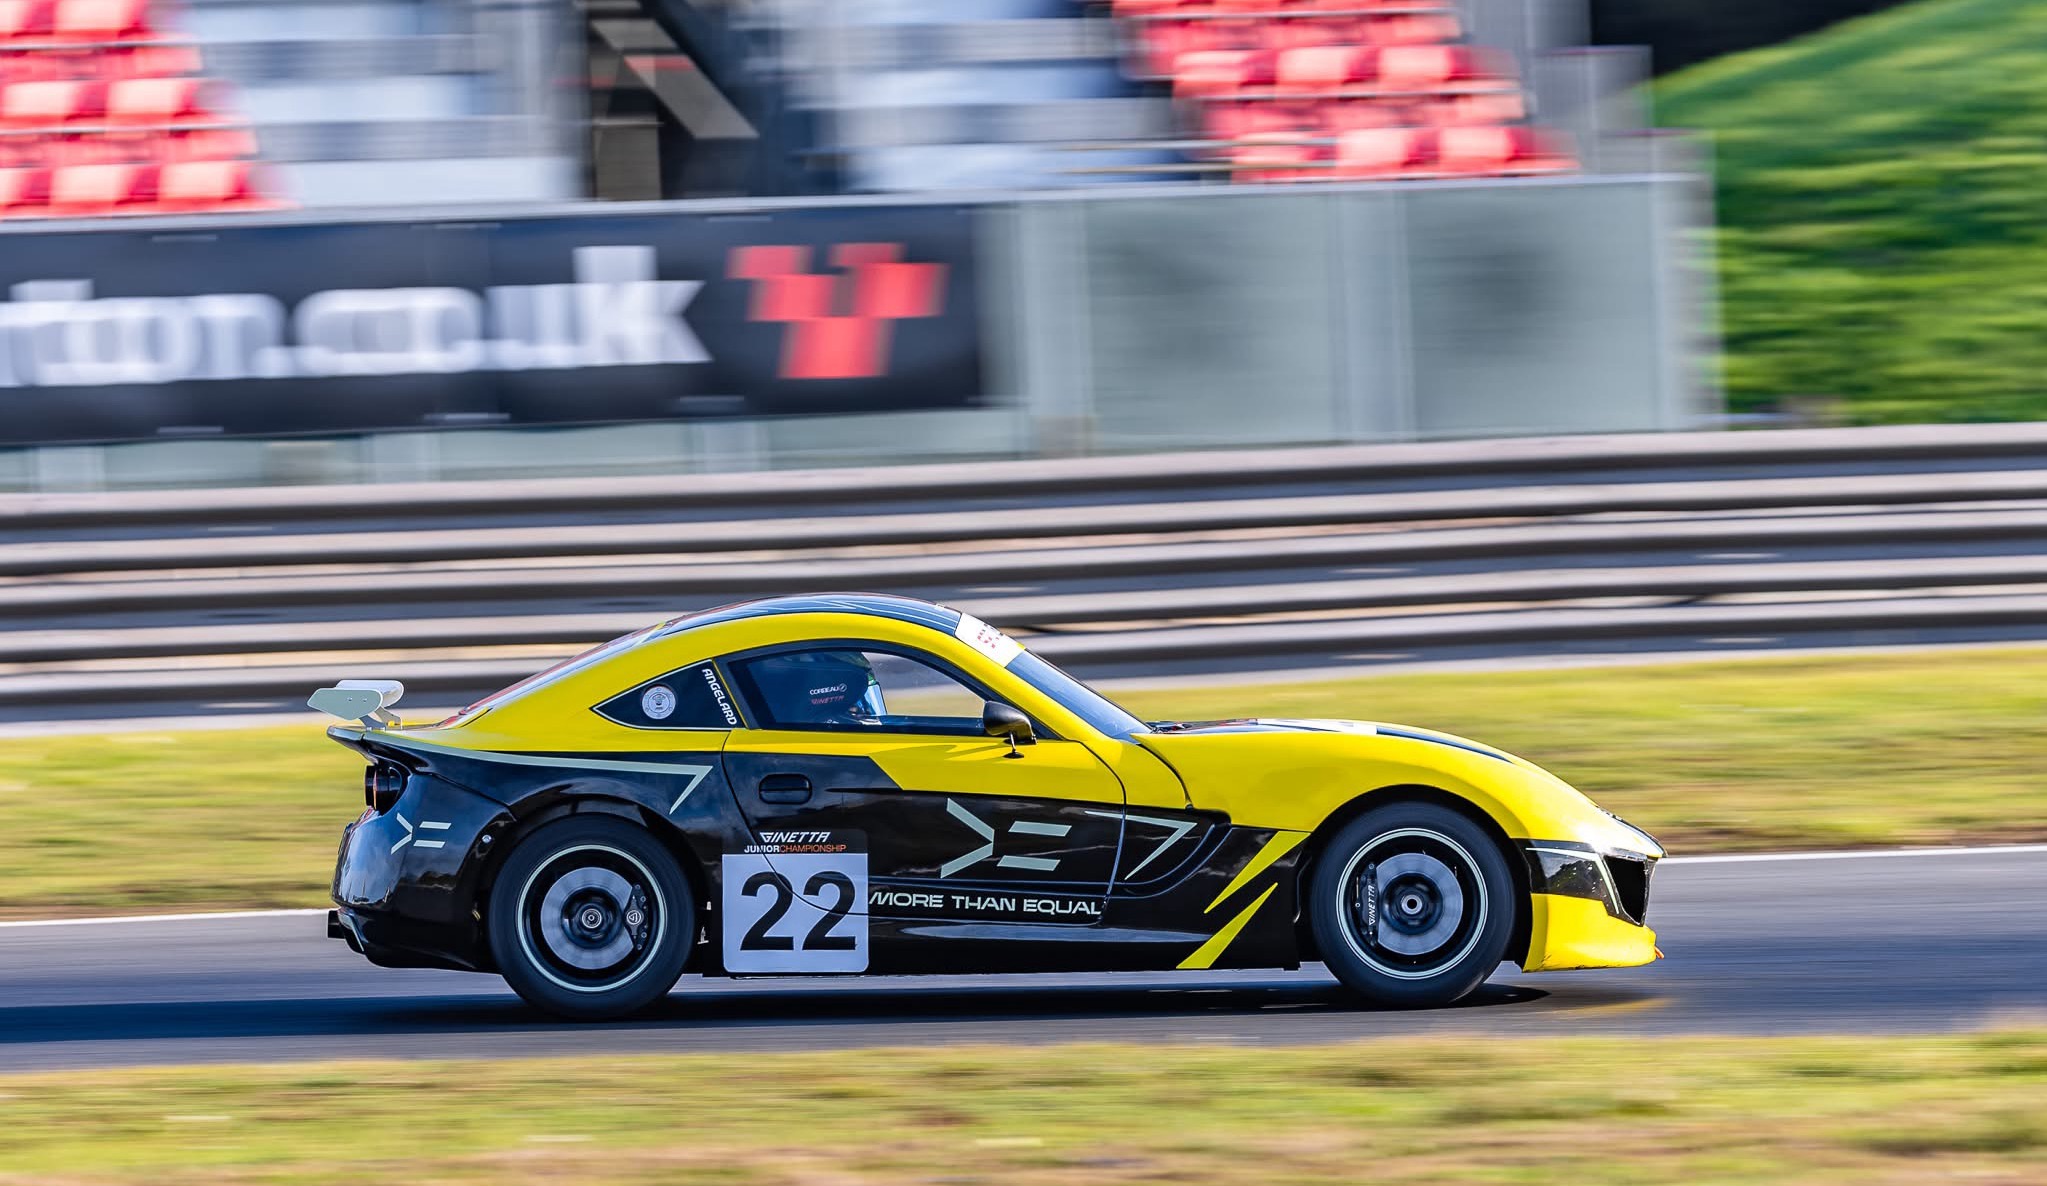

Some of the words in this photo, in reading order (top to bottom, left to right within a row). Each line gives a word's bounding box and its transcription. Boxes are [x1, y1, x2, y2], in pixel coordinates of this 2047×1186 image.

[701, 668, 737, 725] ANGELARD
[759, 831, 831, 843] GINETTA
[740, 871, 856, 950] 22
[868, 892, 944, 908] MORE
[951, 895, 1016, 912] THAN
[1023, 898, 1102, 916] EQUAL
